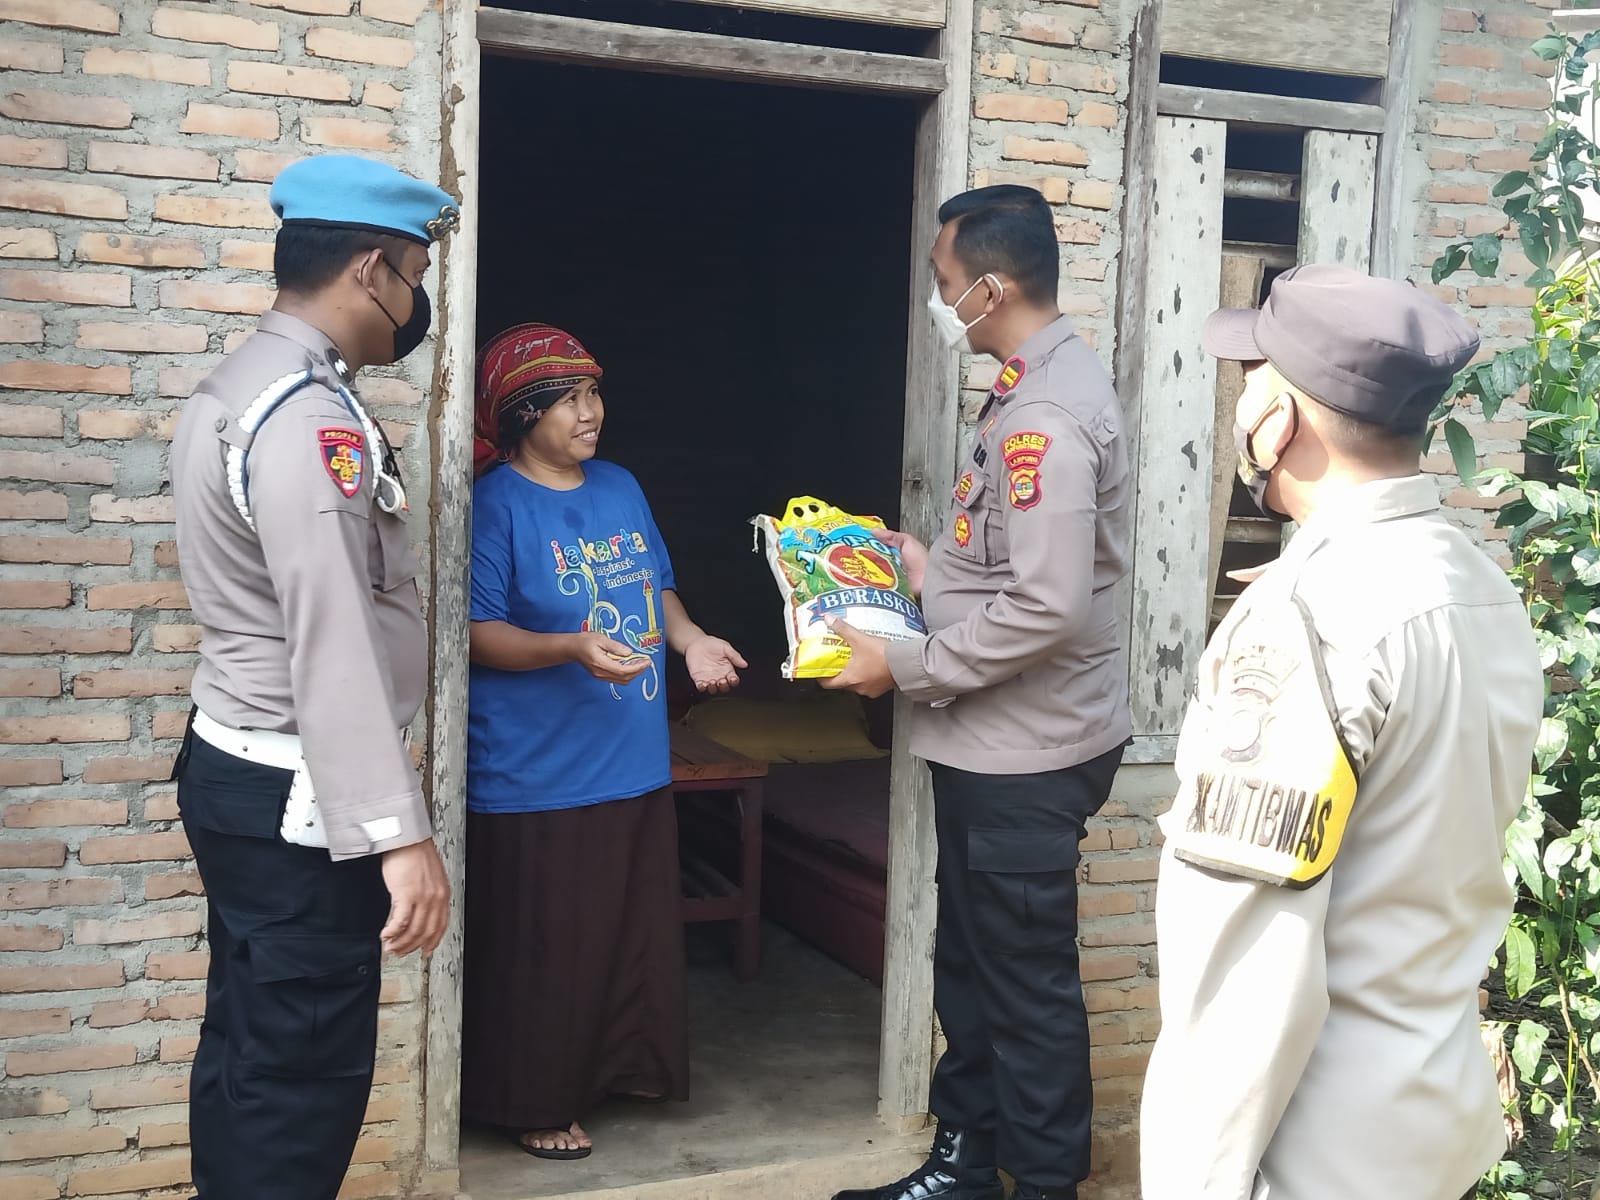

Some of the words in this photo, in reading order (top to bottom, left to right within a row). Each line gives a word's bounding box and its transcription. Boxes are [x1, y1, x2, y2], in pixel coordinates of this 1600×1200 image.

[1004, 434, 1046, 451] POLRES
[551, 528, 648, 574] jakarta
[822, 588, 917, 619] BERASKU
